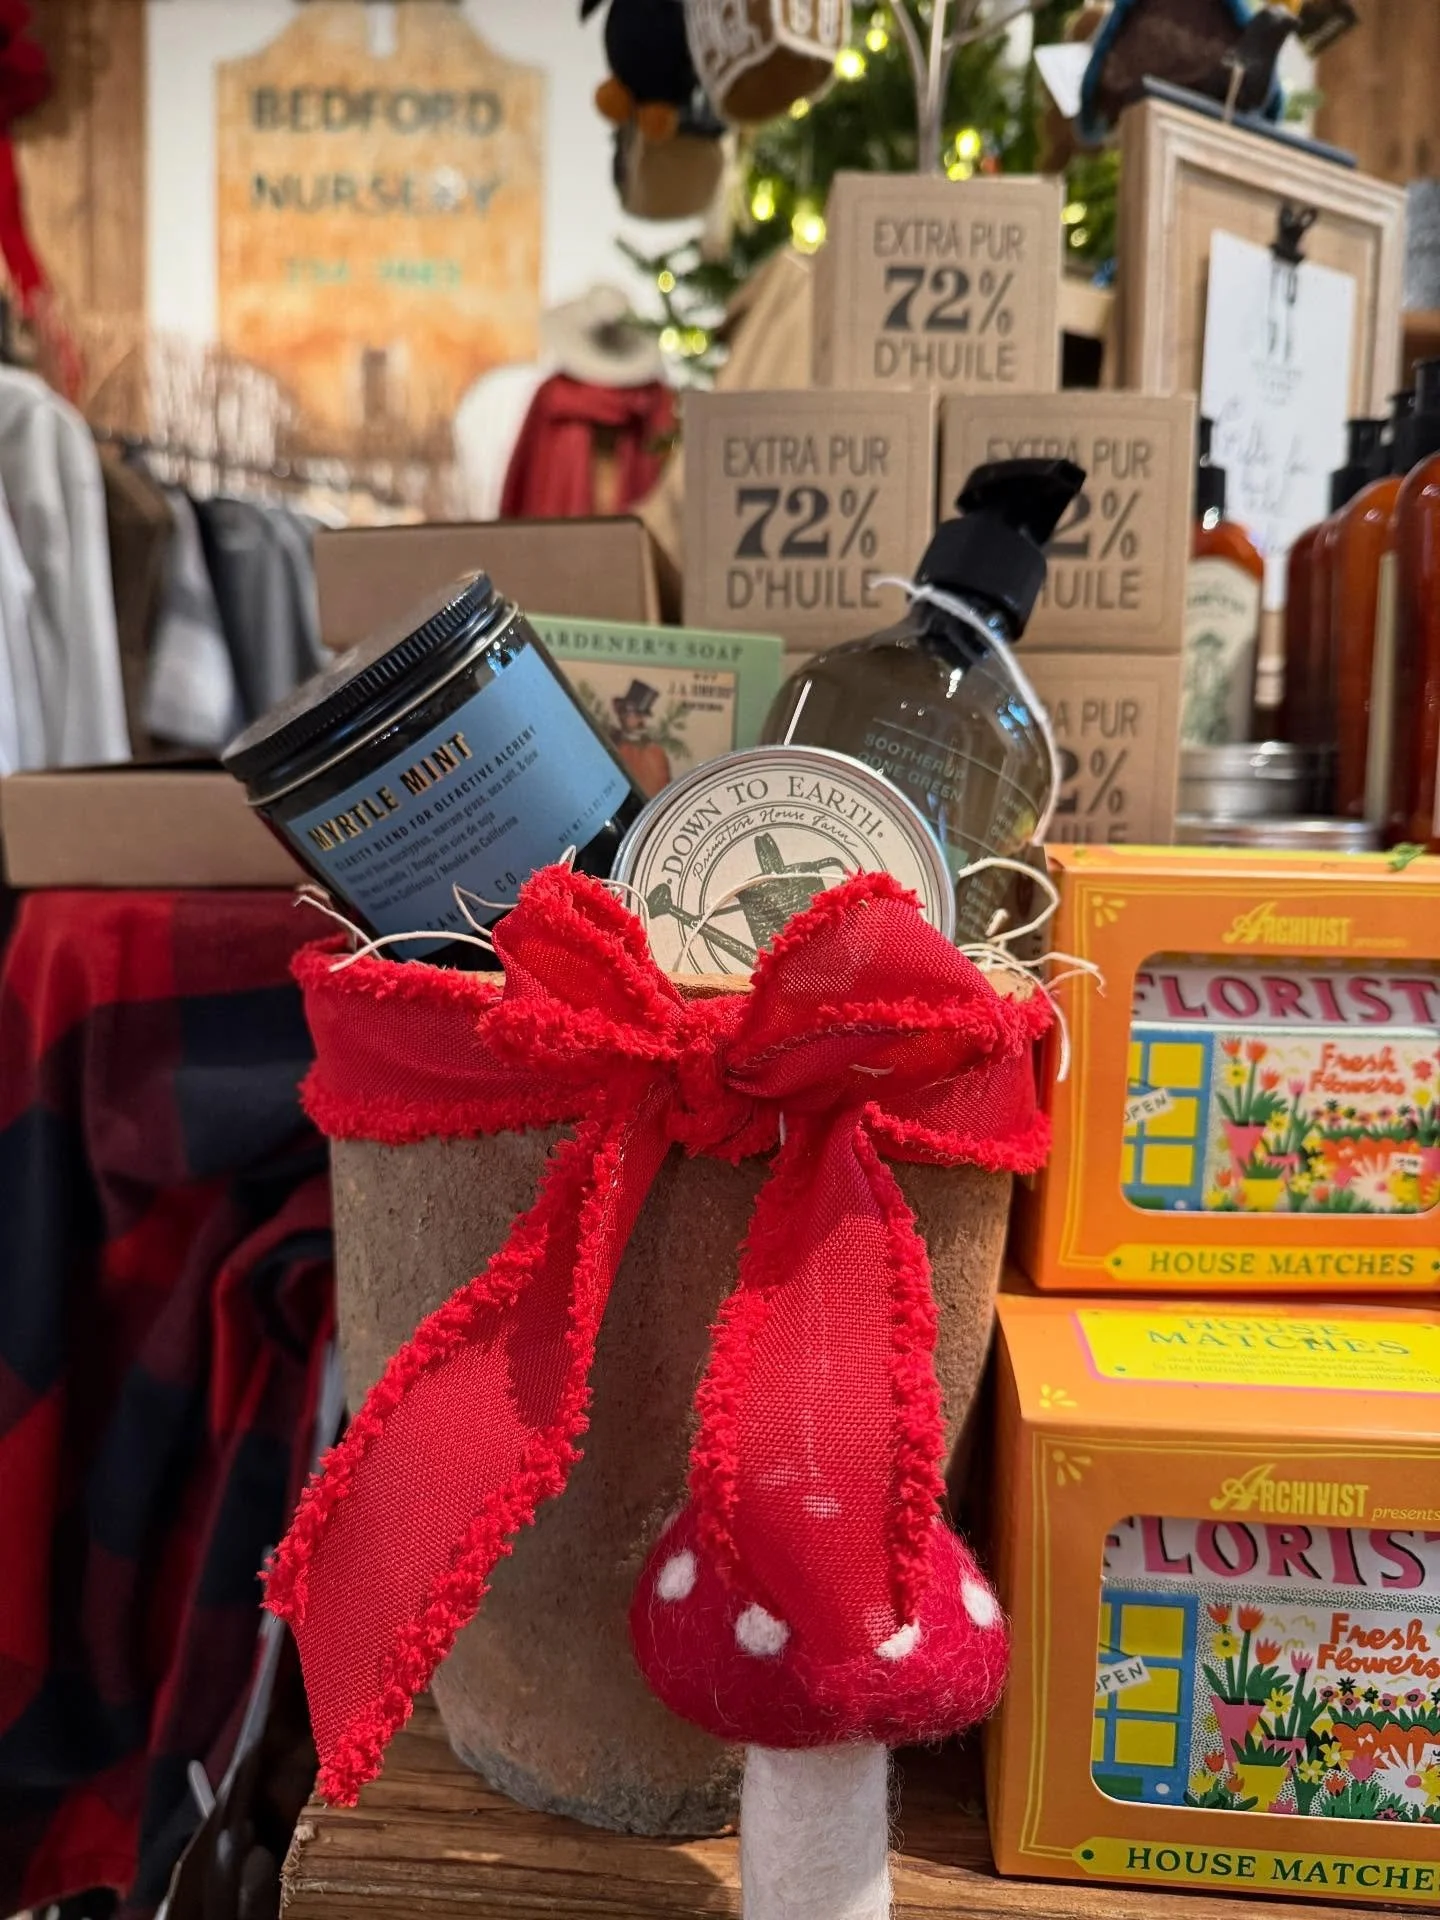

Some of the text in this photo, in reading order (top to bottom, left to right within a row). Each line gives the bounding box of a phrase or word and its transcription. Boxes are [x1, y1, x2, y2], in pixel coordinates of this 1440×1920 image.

[254, 87, 503, 136] BEDFORD
[873, 219, 1025, 262] EXTRA PUR
[883, 266, 1015, 337] 72%
[873, 338, 1017, 382] D'HUILE
[722, 435, 890, 478] EXTRA PUR
[1092, 438, 1154, 480] PUR
[734, 485, 879, 560] 72%
[1044, 489, 1142, 561] 2%
[727, 568, 882, 610] D'HUILE
[545, 632, 743, 663] ARDENER'S SOAP
[1081, 699, 1139, 738] PUR
[307, 731, 474, 851] MYRTLE MINT
[372, 826, 410, 852] BLEND
[409, 807, 434, 831] FOR
[434, 762, 495, 815] OLFACTIVE
[908, 771, 962, 803] GREEN
[662, 797, 723, 878] DOWN
[727, 778, 769, 805] TO
[787, 775, 882, 838] EARTH
[692, 808, 859, 882] Primitive House Farm
[1320, 1042, 1398, 1074] Fresh
[1309, 1069, 1405, 1096] Flowers
[1148, 1252, 1415, 1276] HOUSE MATCHES
[1148, 1330, 1410, 1356] MATCHES
[1184, 1318, 1348, 1336] HOUSE
[1371, 1506, 1440, 1521] presents
[1330, 1612, 1431, 1652] Fresh
[1317, 1643, 1440, 1680] Flowers
[1126, 1847, 1440, 1891] HOUSE MATCHE
